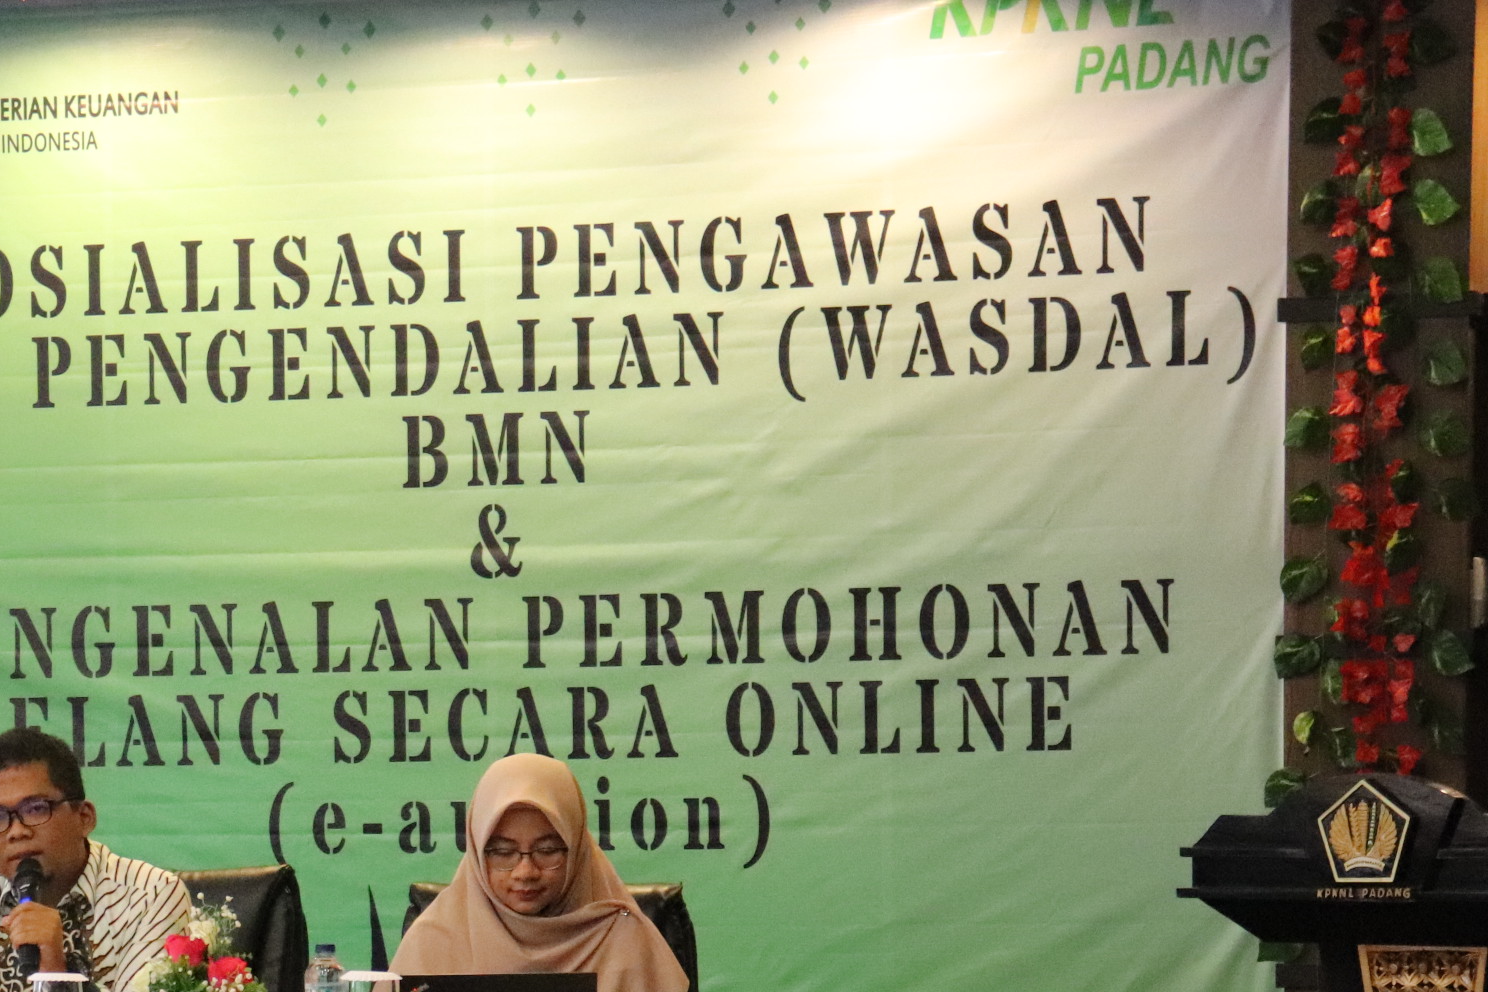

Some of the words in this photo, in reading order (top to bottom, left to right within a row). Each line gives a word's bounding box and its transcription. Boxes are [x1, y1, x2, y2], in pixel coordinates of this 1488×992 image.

[1073, 34, 1271, 94] PADANG
[2, 132, 97, 153] INDONESIA
[65, 91, 178, 118] KEUANGAN
[515, 196, 1150, 299] PENGAWASAN
[31, 310, 723, 409] PENGENDALIAN
[777, 286, 1256, 402] (WASDAL)
[403, 411, 589, 488] BMN
[471, 505, 522, 579] &
[521, 578, 1174, 668] PERMOHONAN
[334, 684, 678, 763] SECARA
[726, 676, 1071, 756] ONLINE
[268, 774, 771, 869] (e-aion)
[1361, 888, 1411, 898] PADANG
